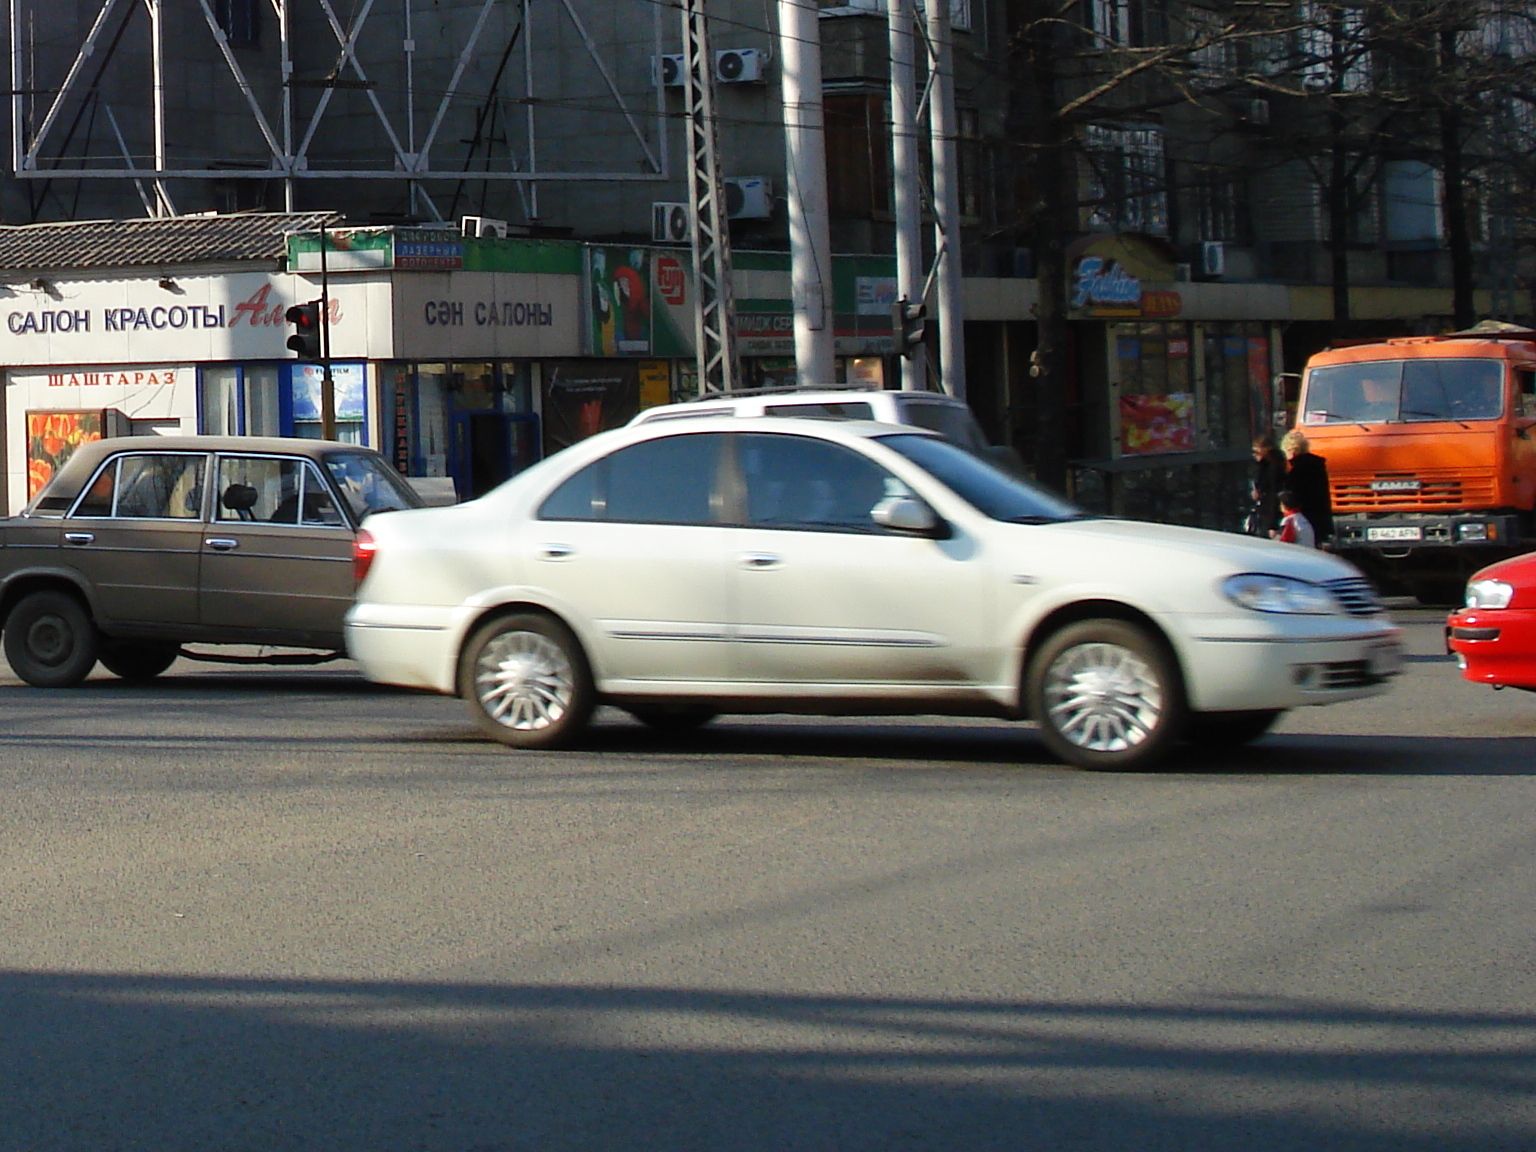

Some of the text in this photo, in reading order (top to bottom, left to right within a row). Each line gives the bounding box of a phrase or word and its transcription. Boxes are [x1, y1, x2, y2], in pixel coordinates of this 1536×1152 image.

[7, 305, 225, 335] САЛОН КРАСОТЫ
[424, 301, 552, 326] СӘН САЛОНЫ
[48, 372, 176, 387] ШАШТАРАЗ
